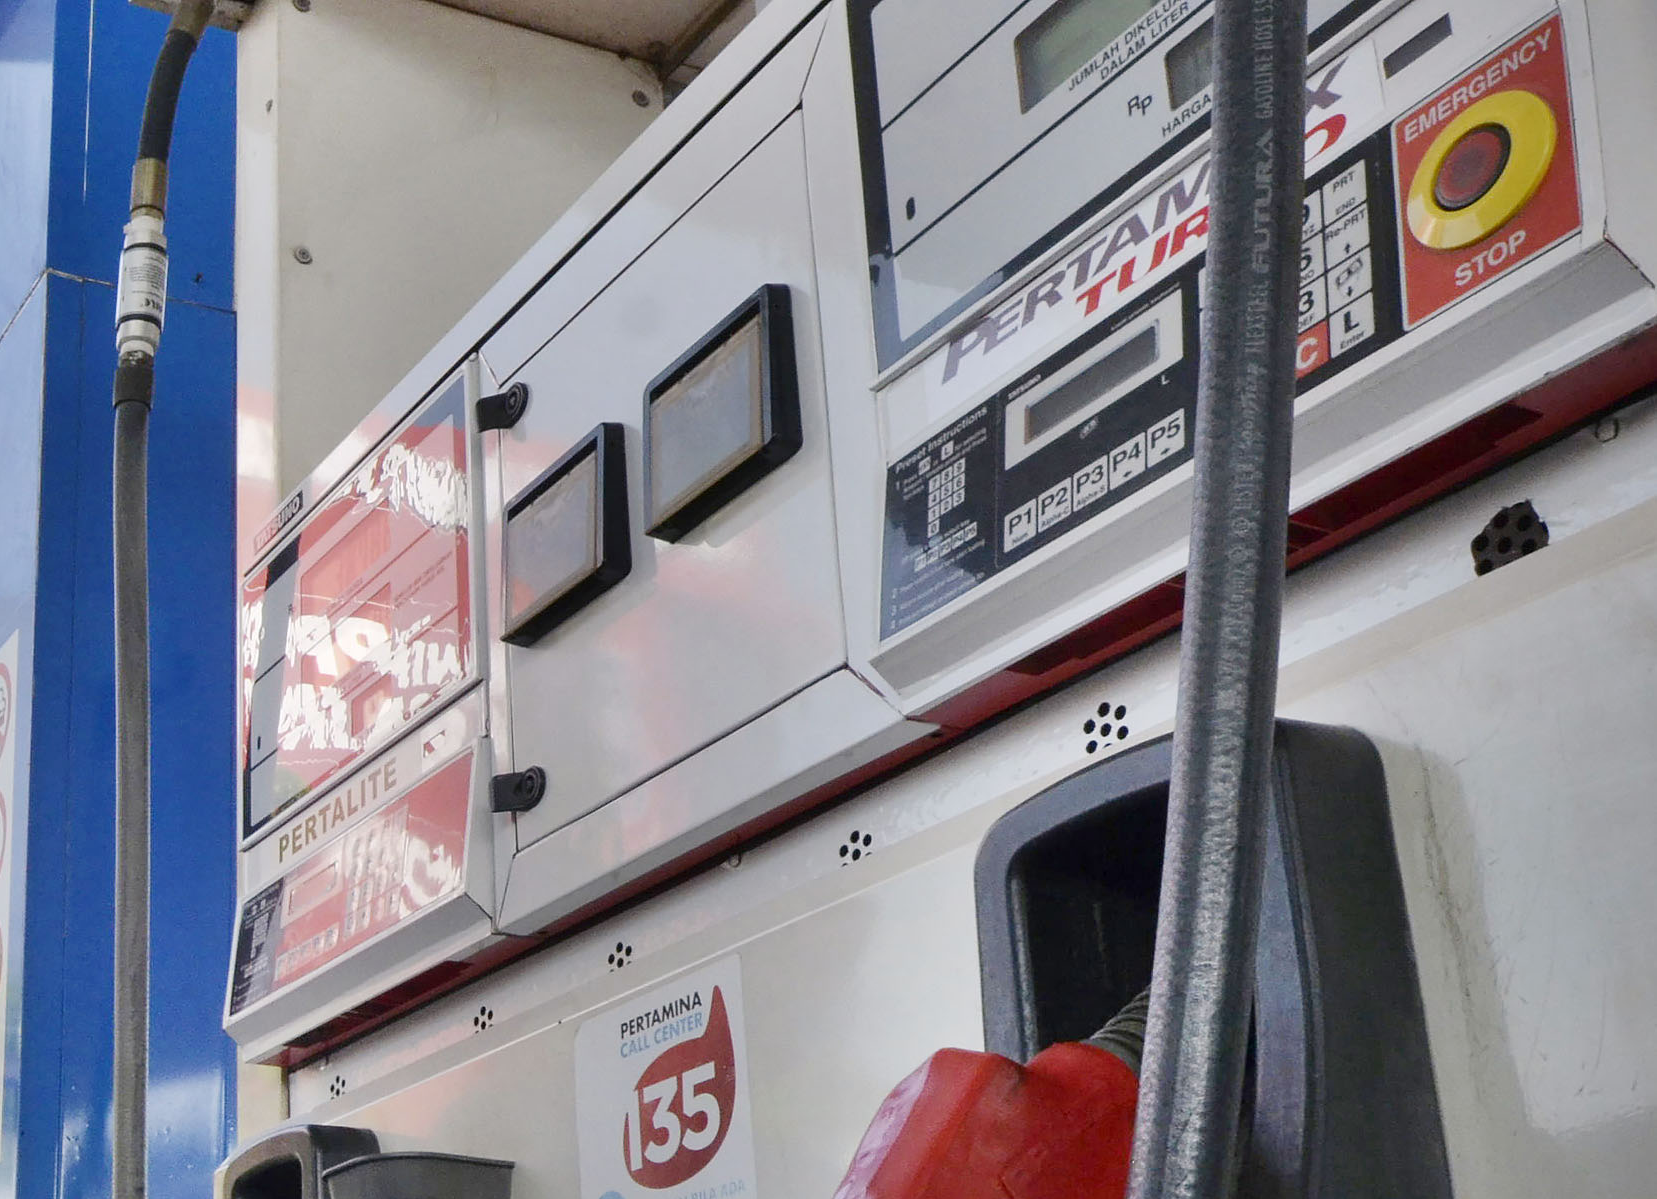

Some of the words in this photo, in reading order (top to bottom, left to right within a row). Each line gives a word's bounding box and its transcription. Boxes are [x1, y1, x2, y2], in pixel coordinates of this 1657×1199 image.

[1100, 39, 1147, 81] DALAM
[1150, 1, 1190, 38] LITER
[1252, 15, 1274, 51] HOSE
[1068, 42, 1120, 92] JUMLAH
[1253, 54, 1274, 120] GASOLINE
[1403, 27, 1553, 143] EMERGENCY
[1127, 94, 1153, 117] Rp
[1160, 93, 1211, 137] HARGA
[1332, 170, 1356, 194] PRT
[1251, 127, 1273, 274] FUTURA
[1334, 196, 1357, 216] END
[941, 54, 1350, 386] PERTAMX
[1325, 208, 1367, 242] Re-PRT
[1454, 229, 1527, 287] STOP
[1298, 289, 1315, 317] 3
[1342, 309, 1360, 335] L
[1295, 336, 1319, 370] C
[1339, 329, 1366, 350] Enter
[1160, 374, 1170, 385] L
[894, 447, 928, 475] Preset
[927, 405, 989, 451] Instructions
[1150, 417, 1182, 450] P5
[1111, 443, 1140, 472] P4
[1075, 464, 1105, 495] P3
[1040, 486, 1068, 516] P2
[1008, 507, 1032, 536] P1
[278, 756, 398, 864] PERTALITE
[620, 991, 703, 1039] PERTAMINA
[619, 1038, 651, 1059] CALL
[653, 1012, 704, 1044] CENTER
[627, 1060, 721, 1172] 135
[721, 1179, 746, 1198] ADA
